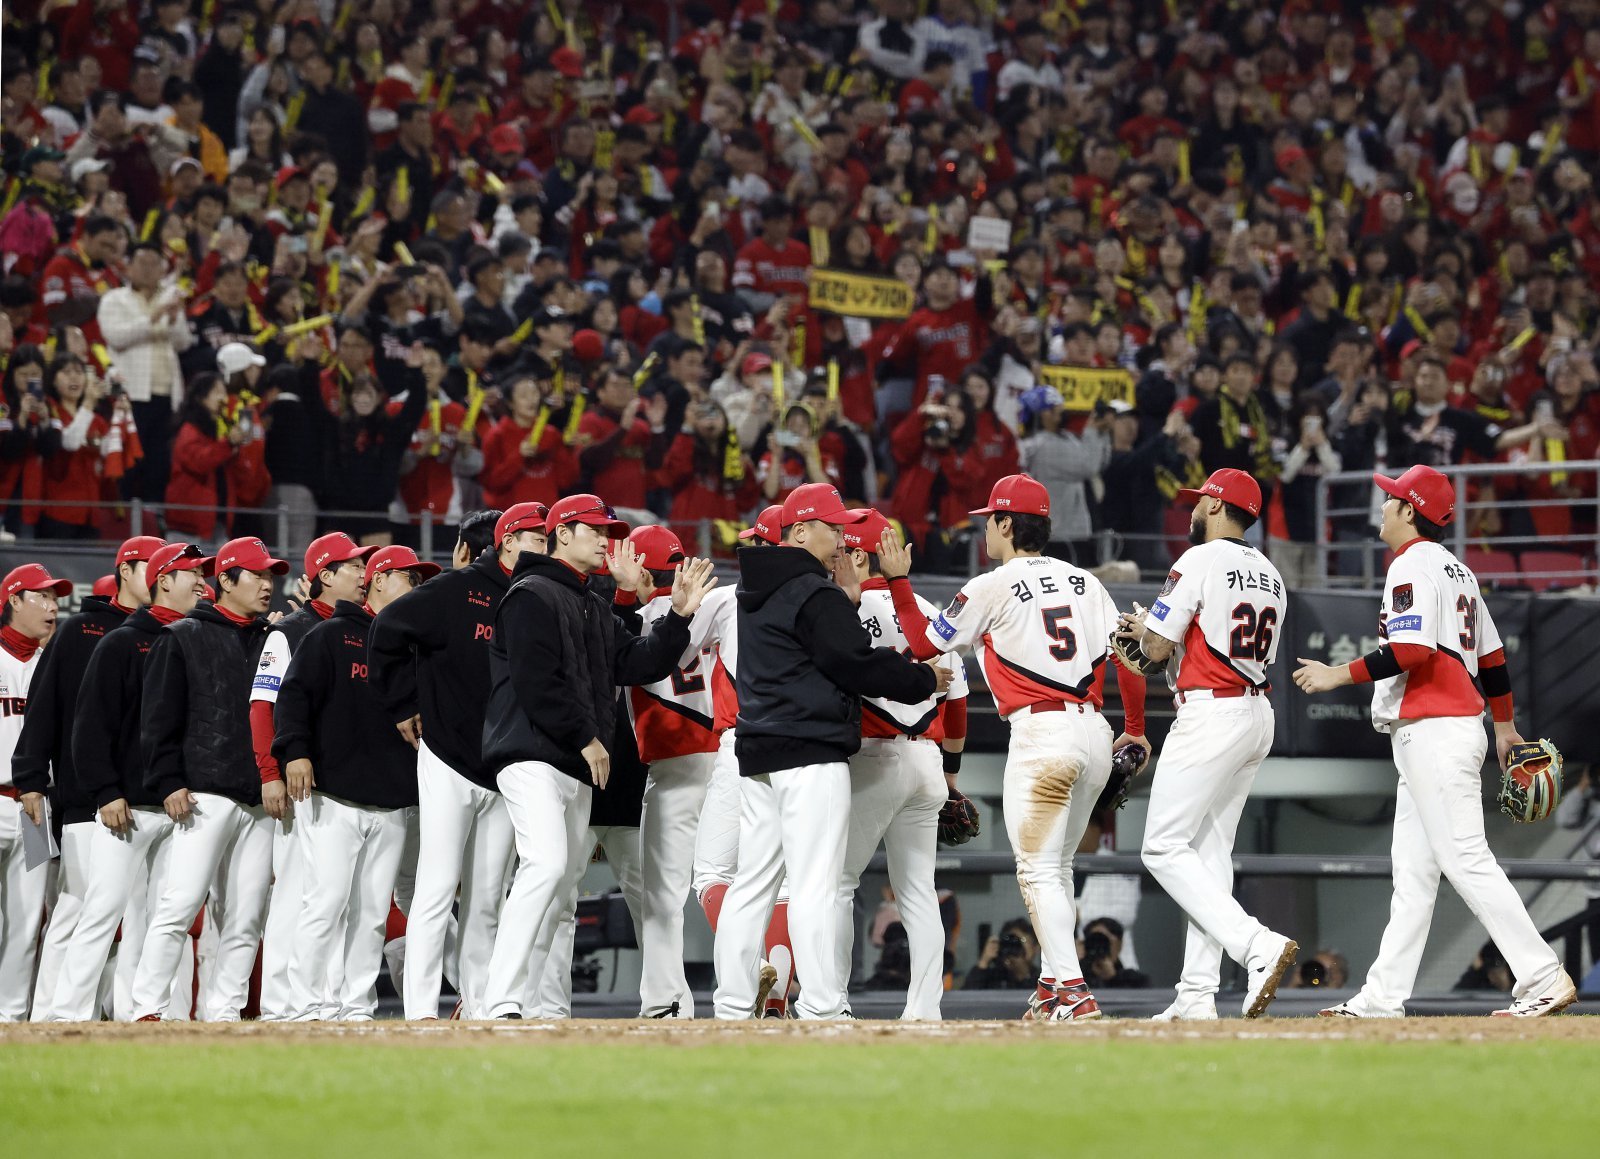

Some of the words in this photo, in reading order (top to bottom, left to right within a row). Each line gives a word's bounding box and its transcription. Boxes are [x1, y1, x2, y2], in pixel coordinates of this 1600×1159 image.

[1011, 575, 1086, 603] 김도영
[1041, 605, 1078, 662] 5
[1229, 601, 1278, 662] 26
